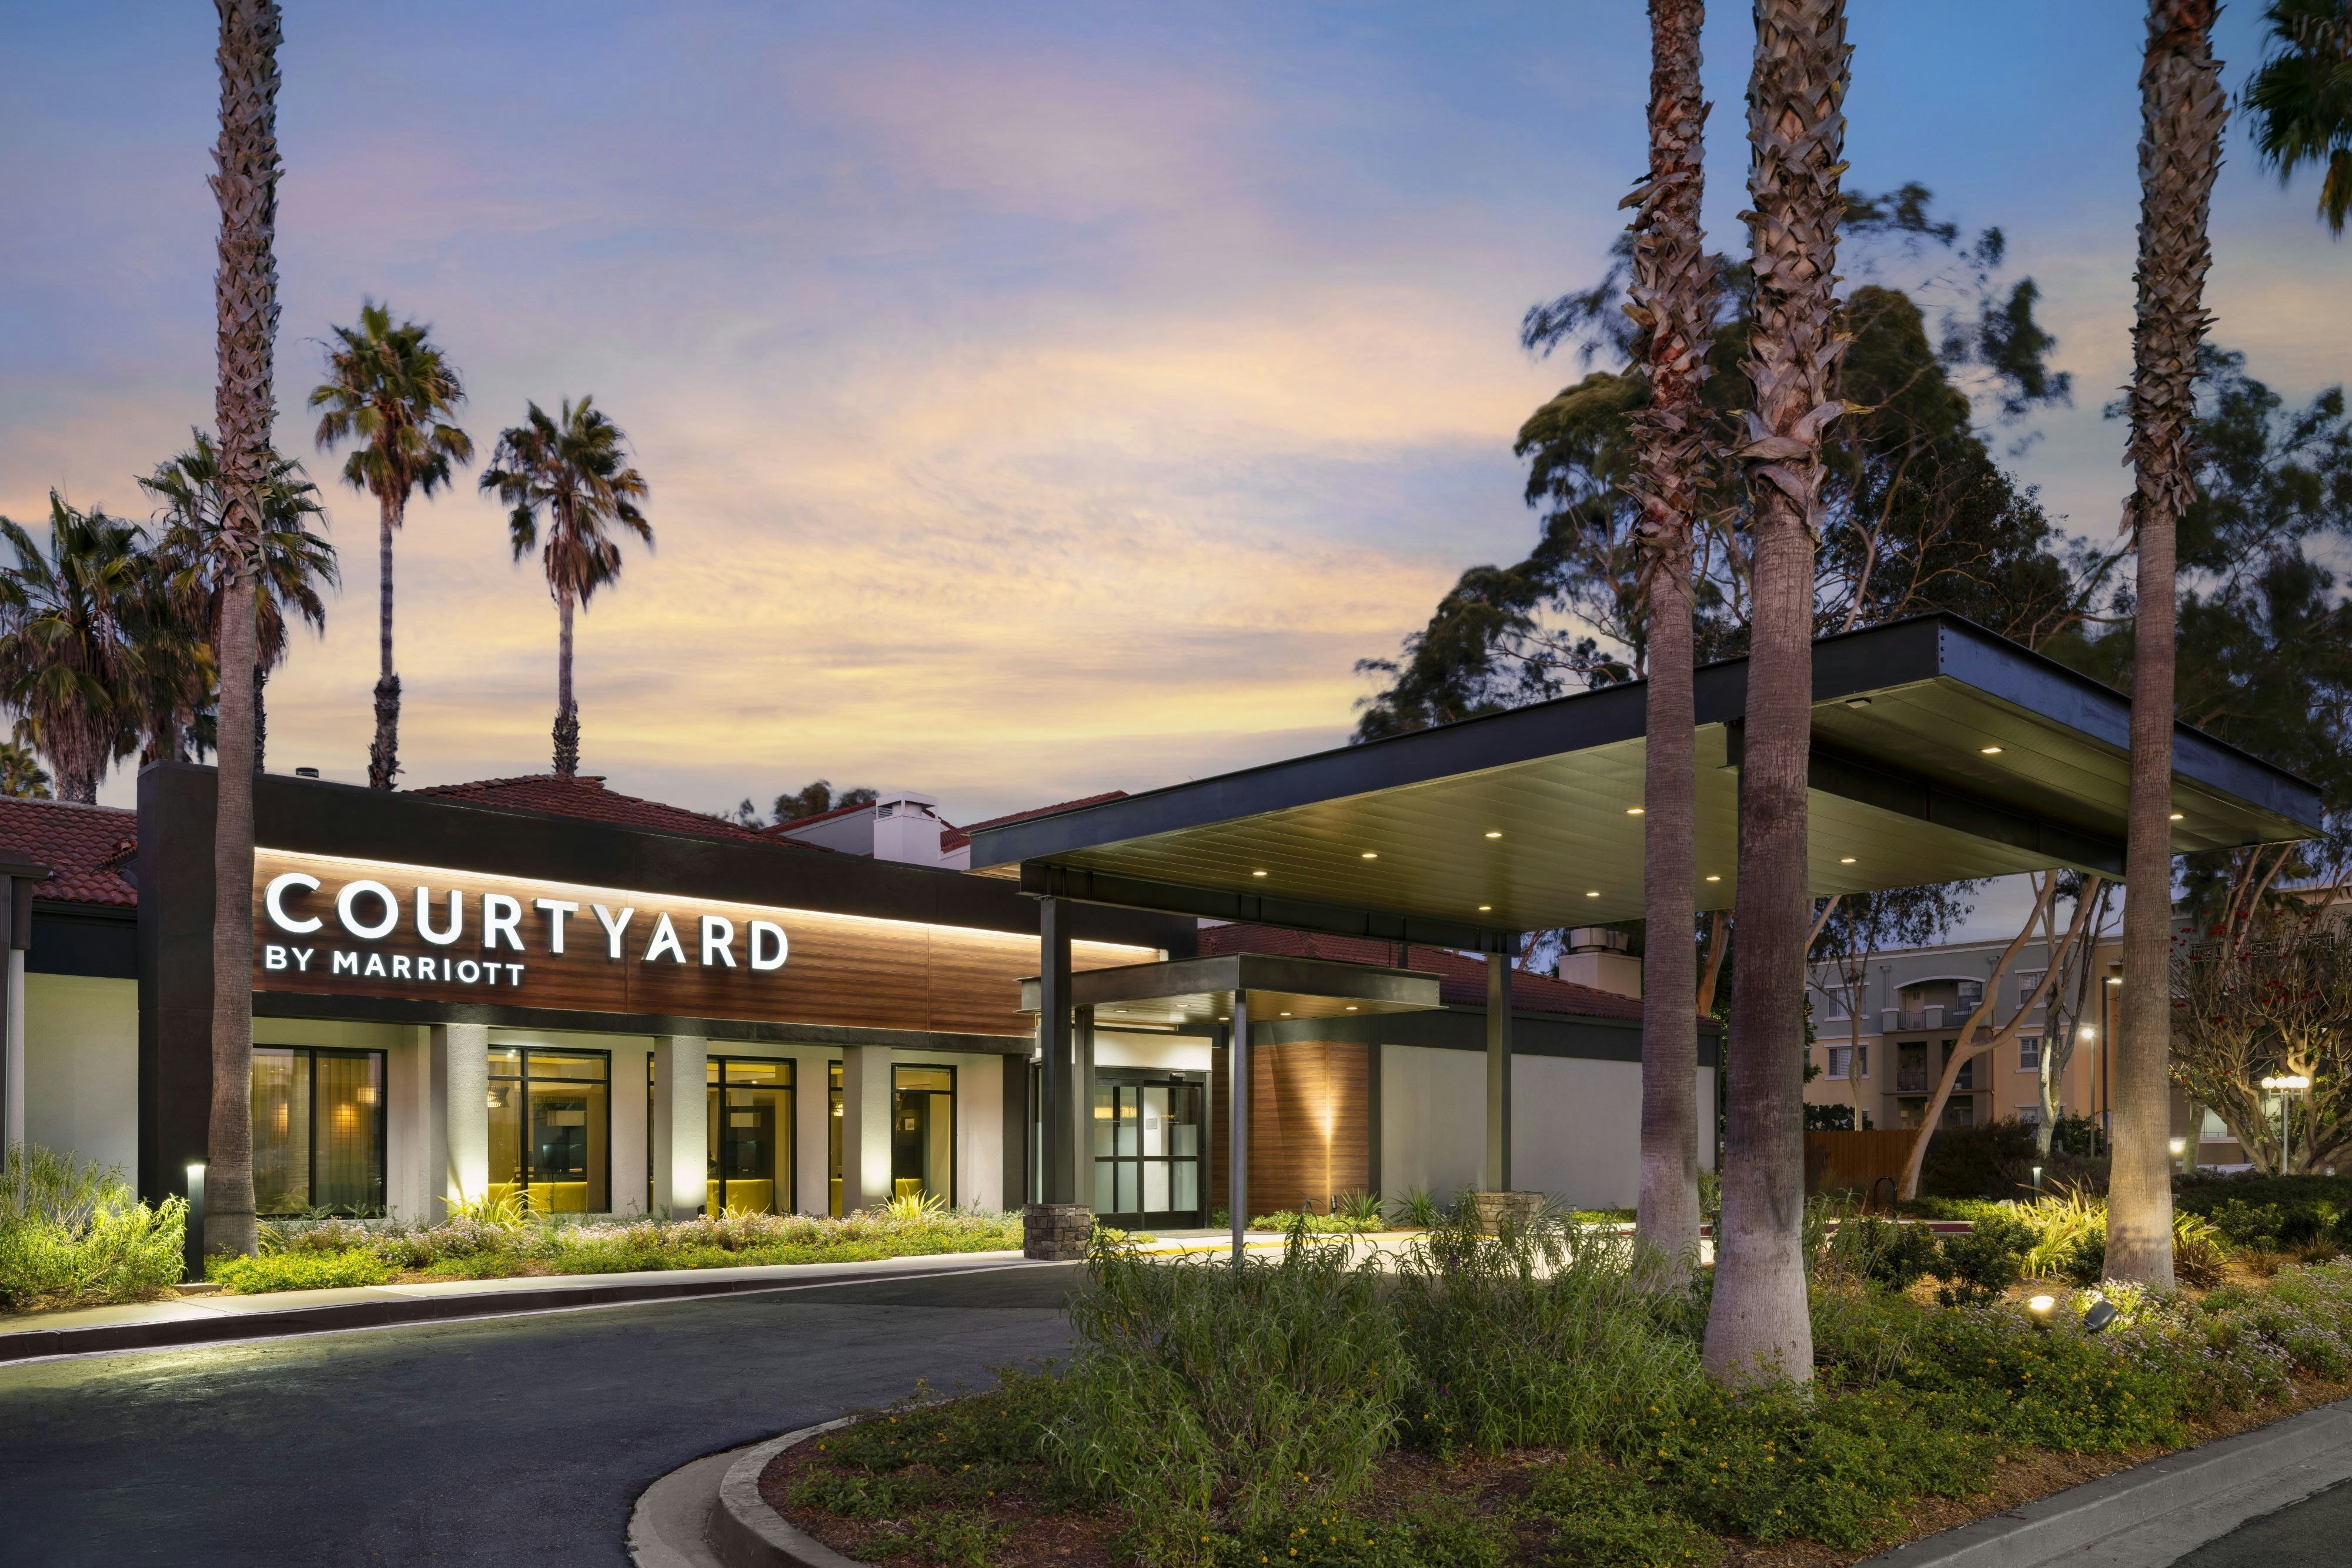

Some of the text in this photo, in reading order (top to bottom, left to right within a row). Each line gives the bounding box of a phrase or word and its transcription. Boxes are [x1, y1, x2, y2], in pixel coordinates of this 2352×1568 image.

[264, 872, 789, 970] COURTYARD
[265, 945, 525, 986] BY MARRIOTT
